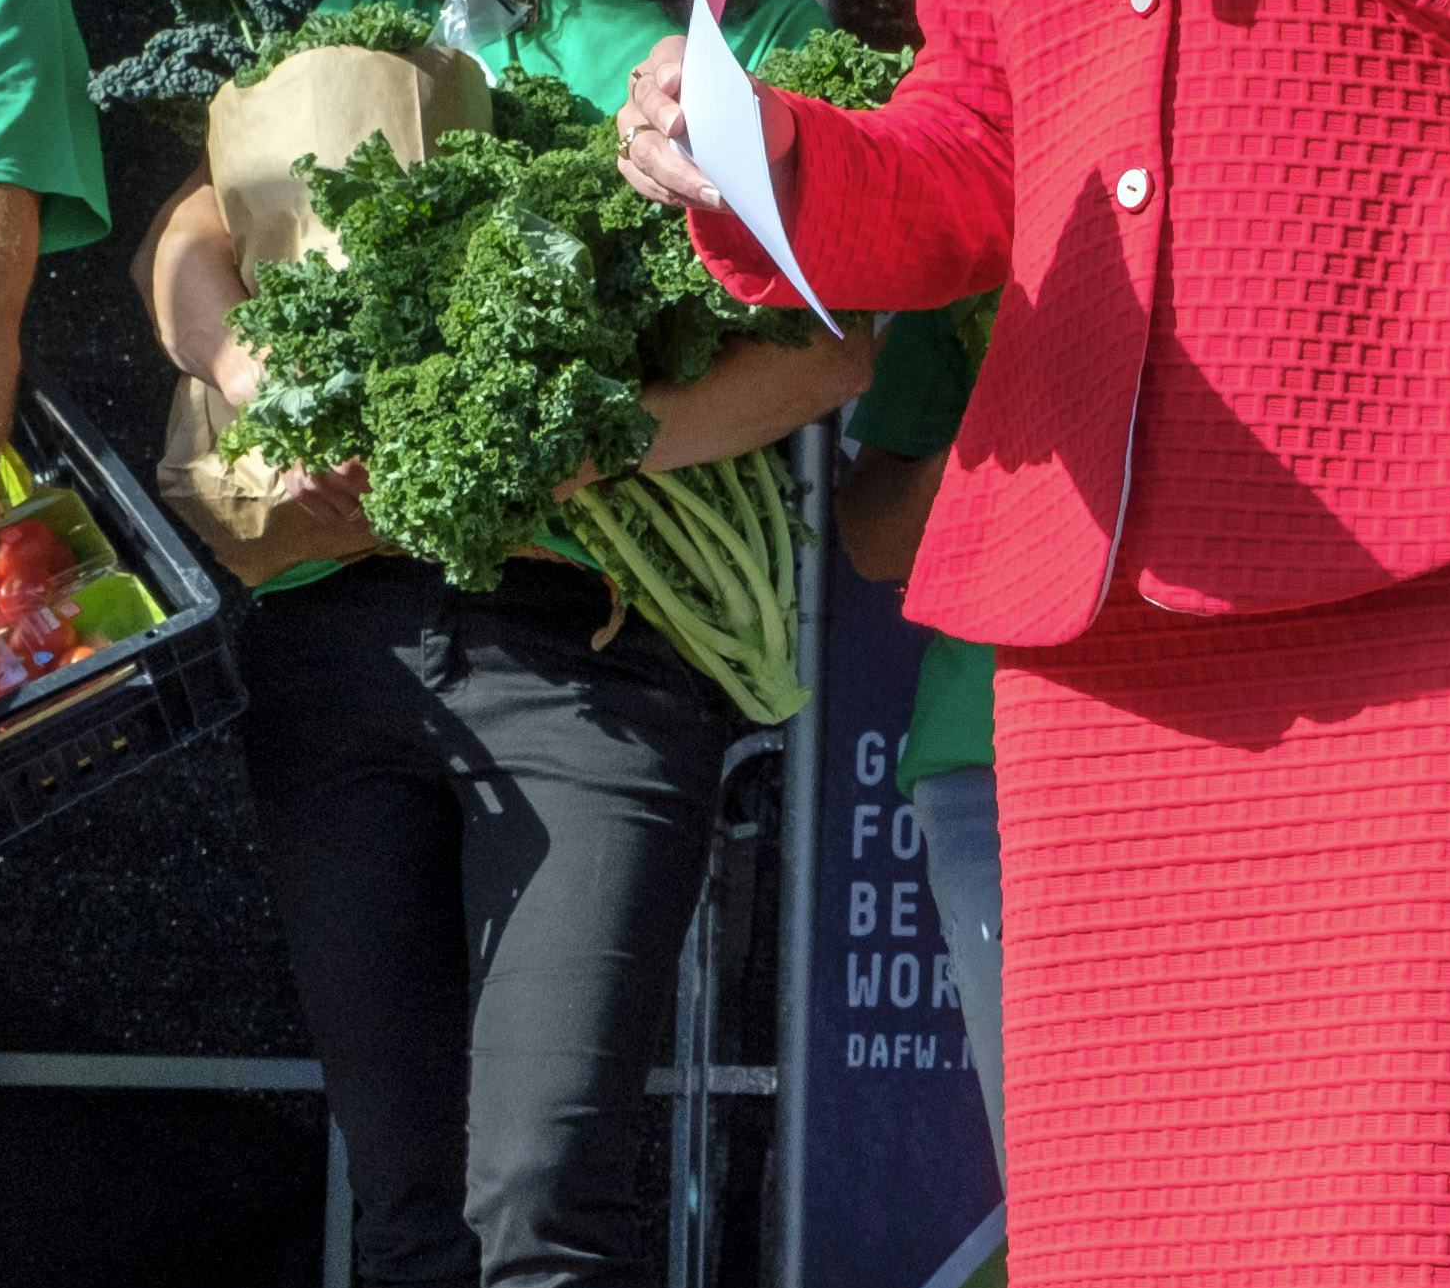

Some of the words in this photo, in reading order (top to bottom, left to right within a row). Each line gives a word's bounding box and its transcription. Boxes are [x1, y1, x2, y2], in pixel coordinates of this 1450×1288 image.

[851, 802, 923, 861] FO
[849, 880, 920, 938] BE
[847, 951, 962, 1010] WOR
[845, 1031, 979, 1070] DAFW.N
